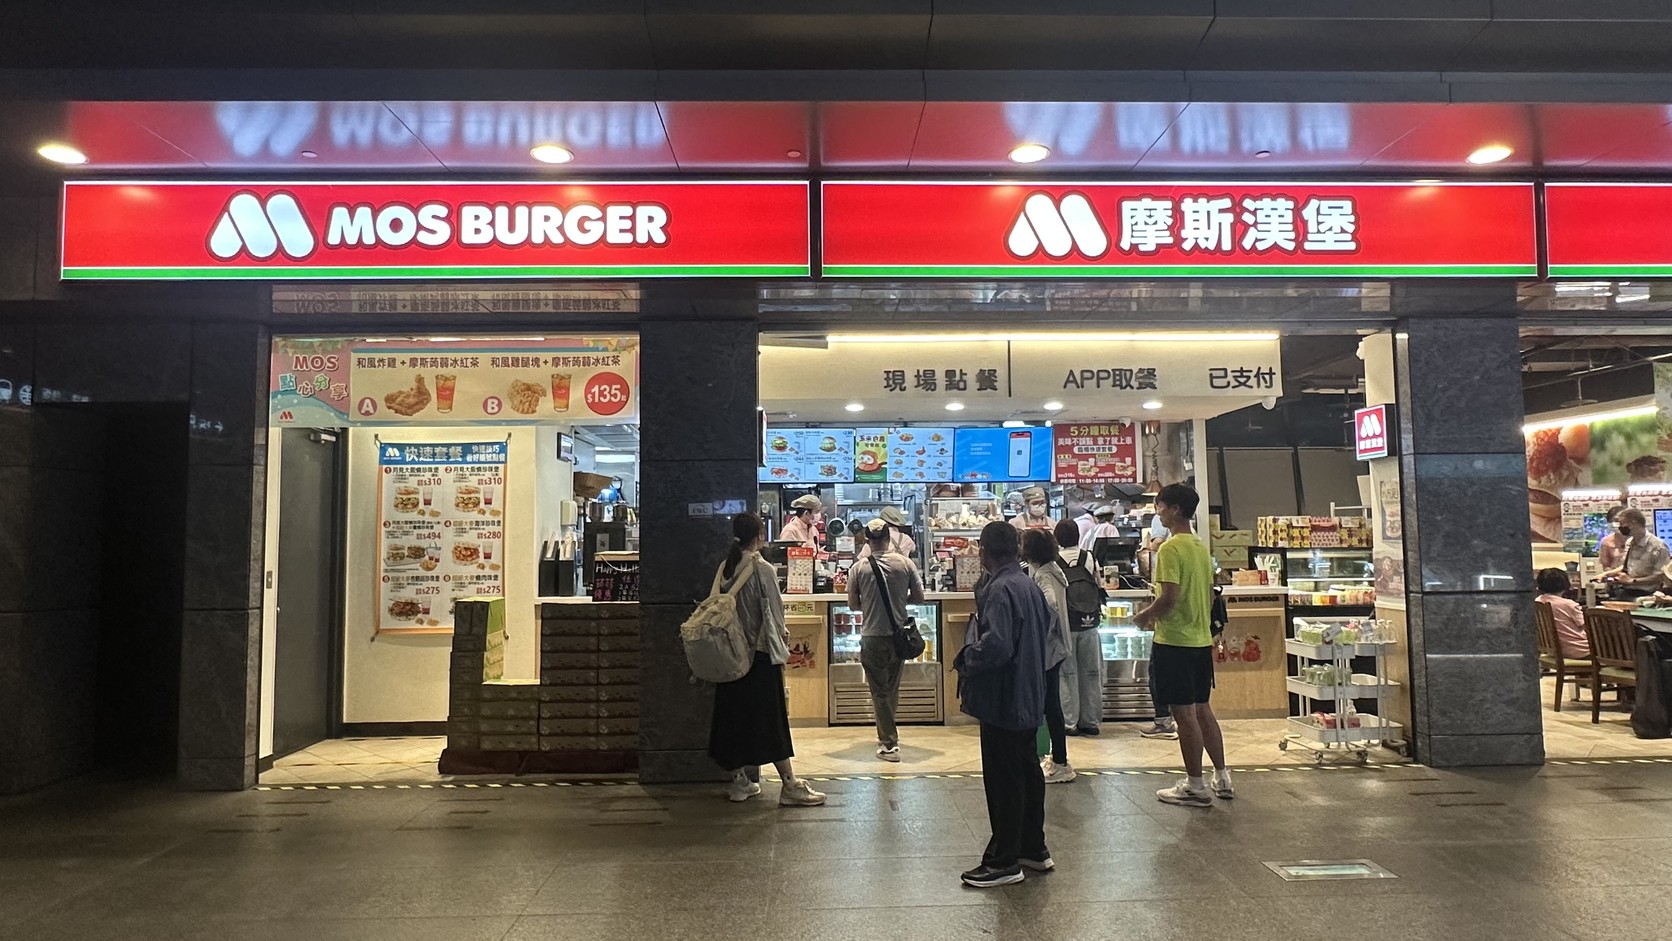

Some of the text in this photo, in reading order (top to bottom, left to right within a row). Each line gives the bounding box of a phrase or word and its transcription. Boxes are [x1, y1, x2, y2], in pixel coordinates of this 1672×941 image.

[327, 204, 667, 246] MOS BURGER
[1119, 197, 1357, 252] 摩斯漢堡
[293, 355, 339, 371] MOS
[279, 373, 348, 400] 點心分享
[883, 368, 999, 393] 現場點餐
[1063, 367, 1158, 391] APP取餐
[1208, 367, 1276, 390] 已支付
[360, 399, 375, 414] A
[405, 446, 463, 462] 快速套餐
